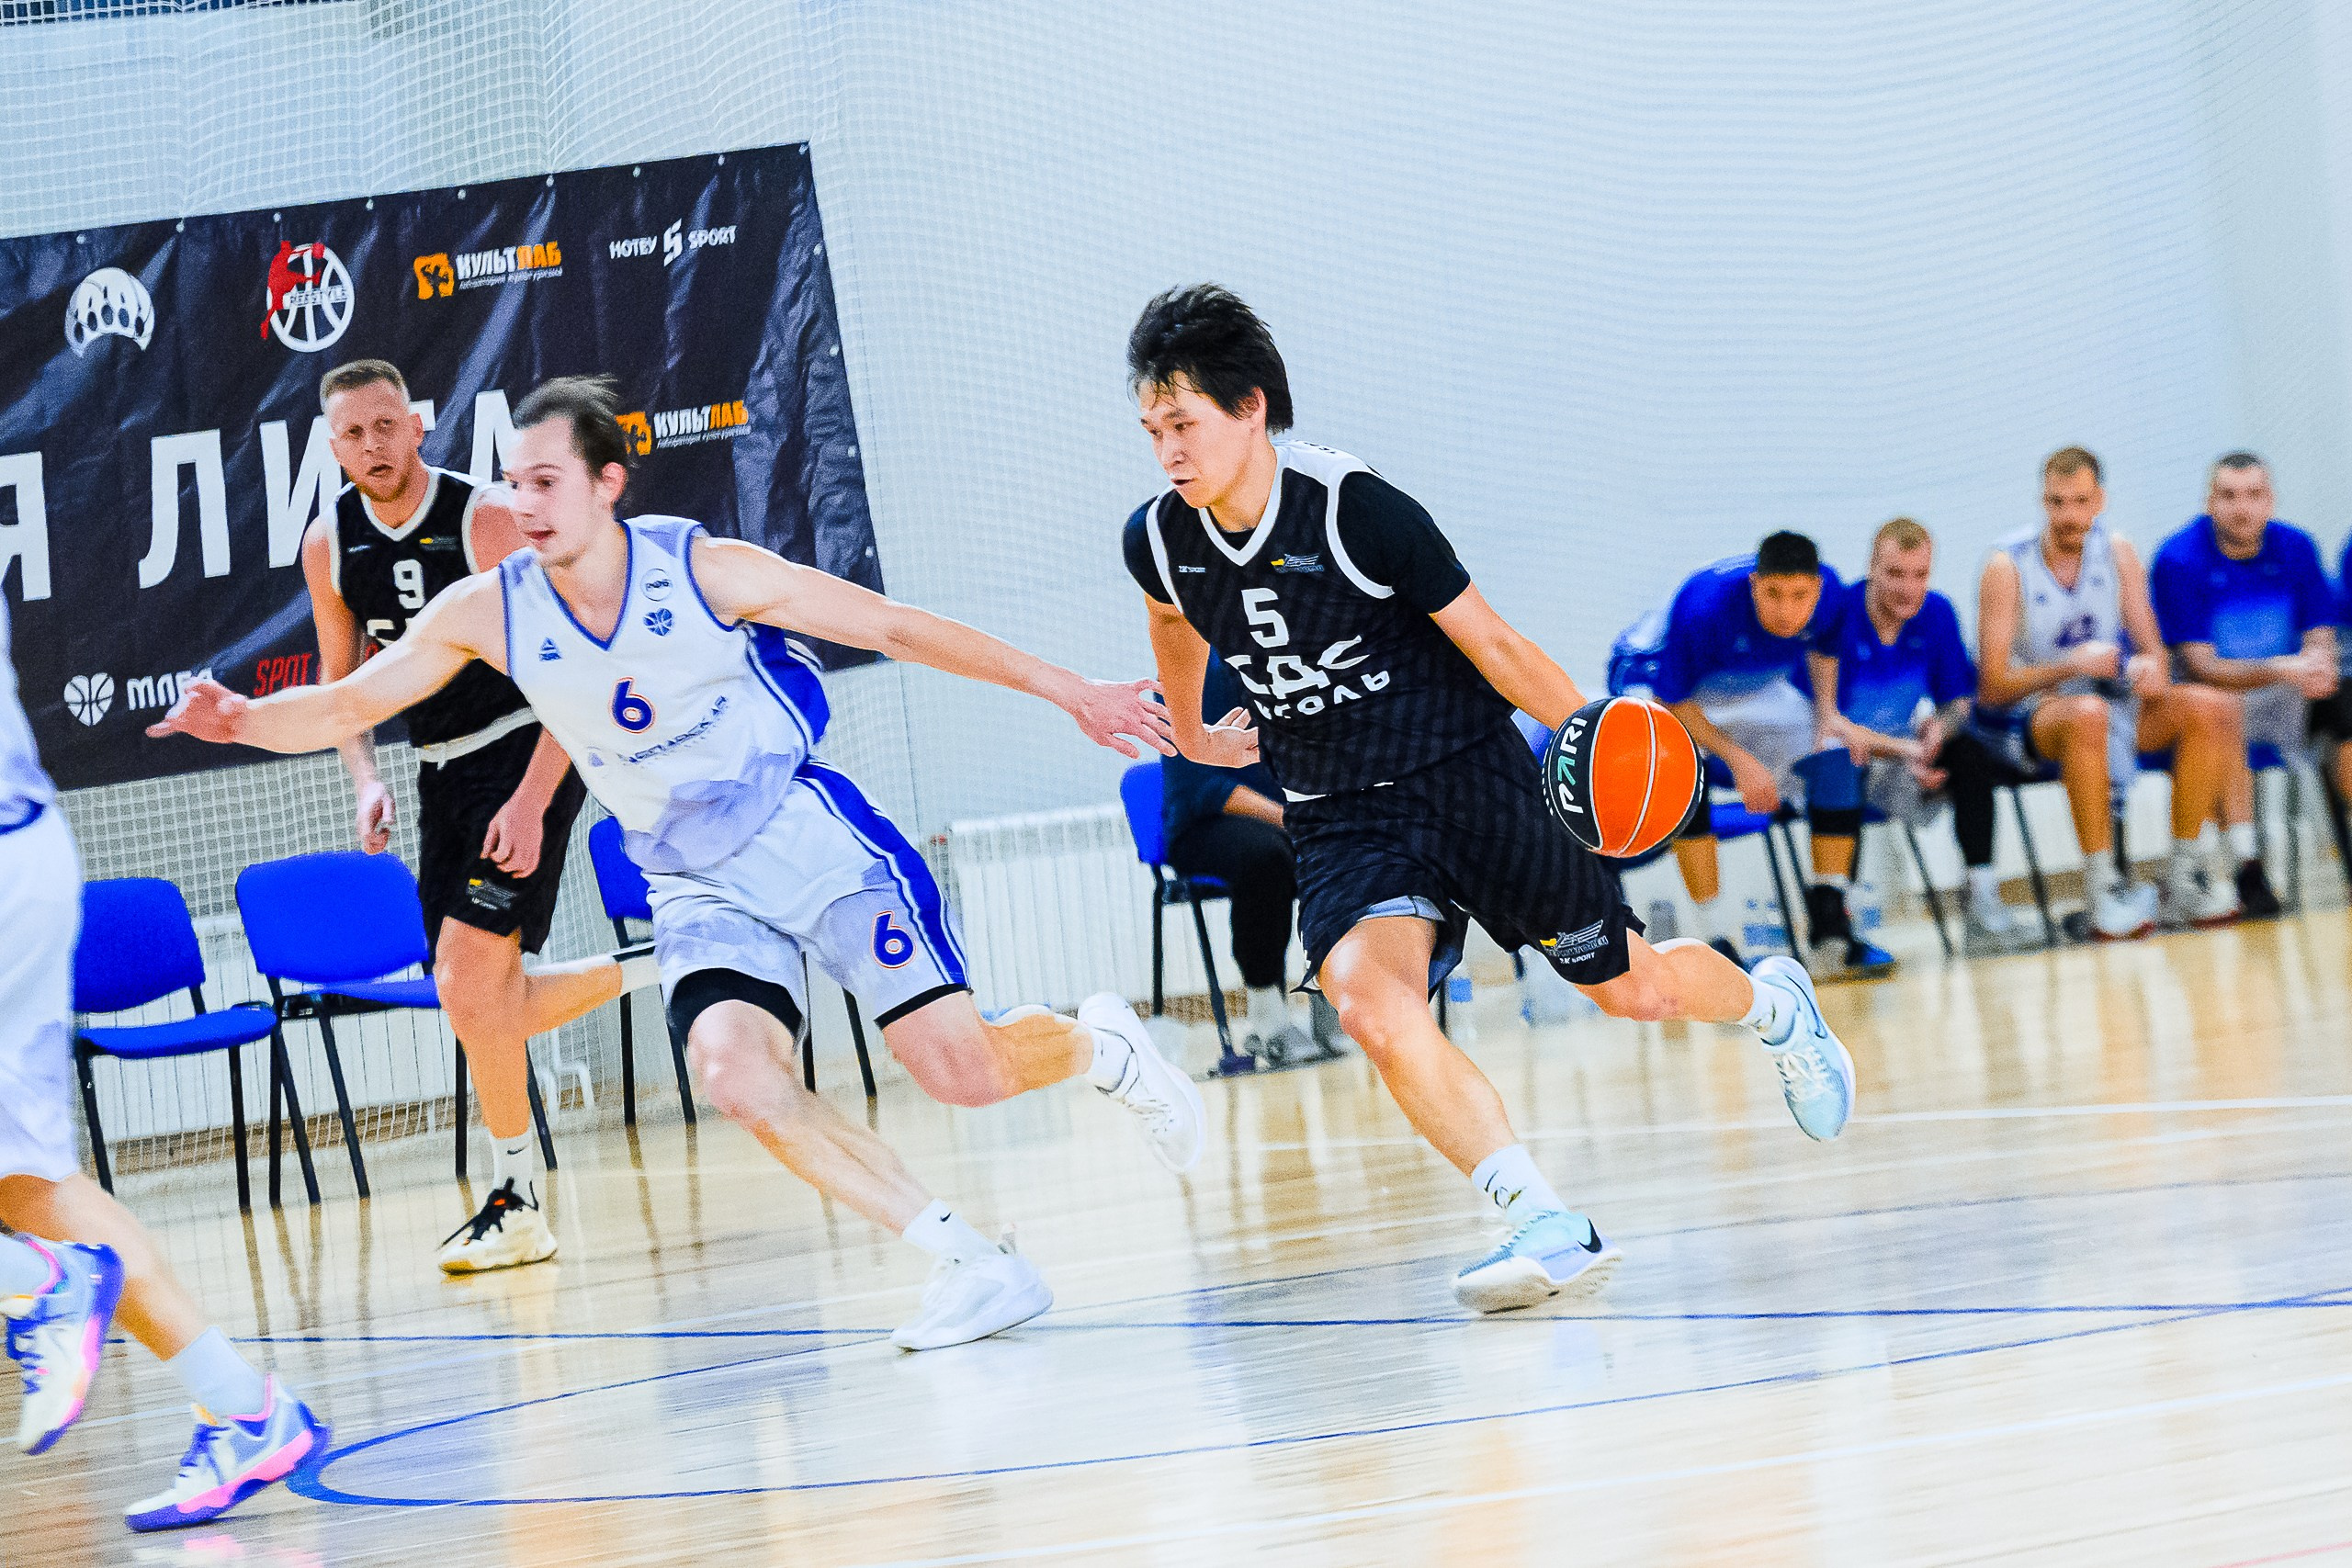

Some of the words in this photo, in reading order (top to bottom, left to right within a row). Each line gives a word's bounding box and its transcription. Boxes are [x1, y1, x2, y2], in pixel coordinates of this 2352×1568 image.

[456, 240, 562, 280] КУЛЬТЛАБ
[609, 235, 657, 260] HOTEY
[688, 225, 737, 250] SPORT
[653, 400, 749, 438] КУЛЬТЛАБ
[393, 558, 425, 609] 9
[1240, 588, 1290, 649] 5
[608, 677, 655, 734] 6
[1558, 716, 1588, 815] PARI
[870, 910, 916, 970] 6
